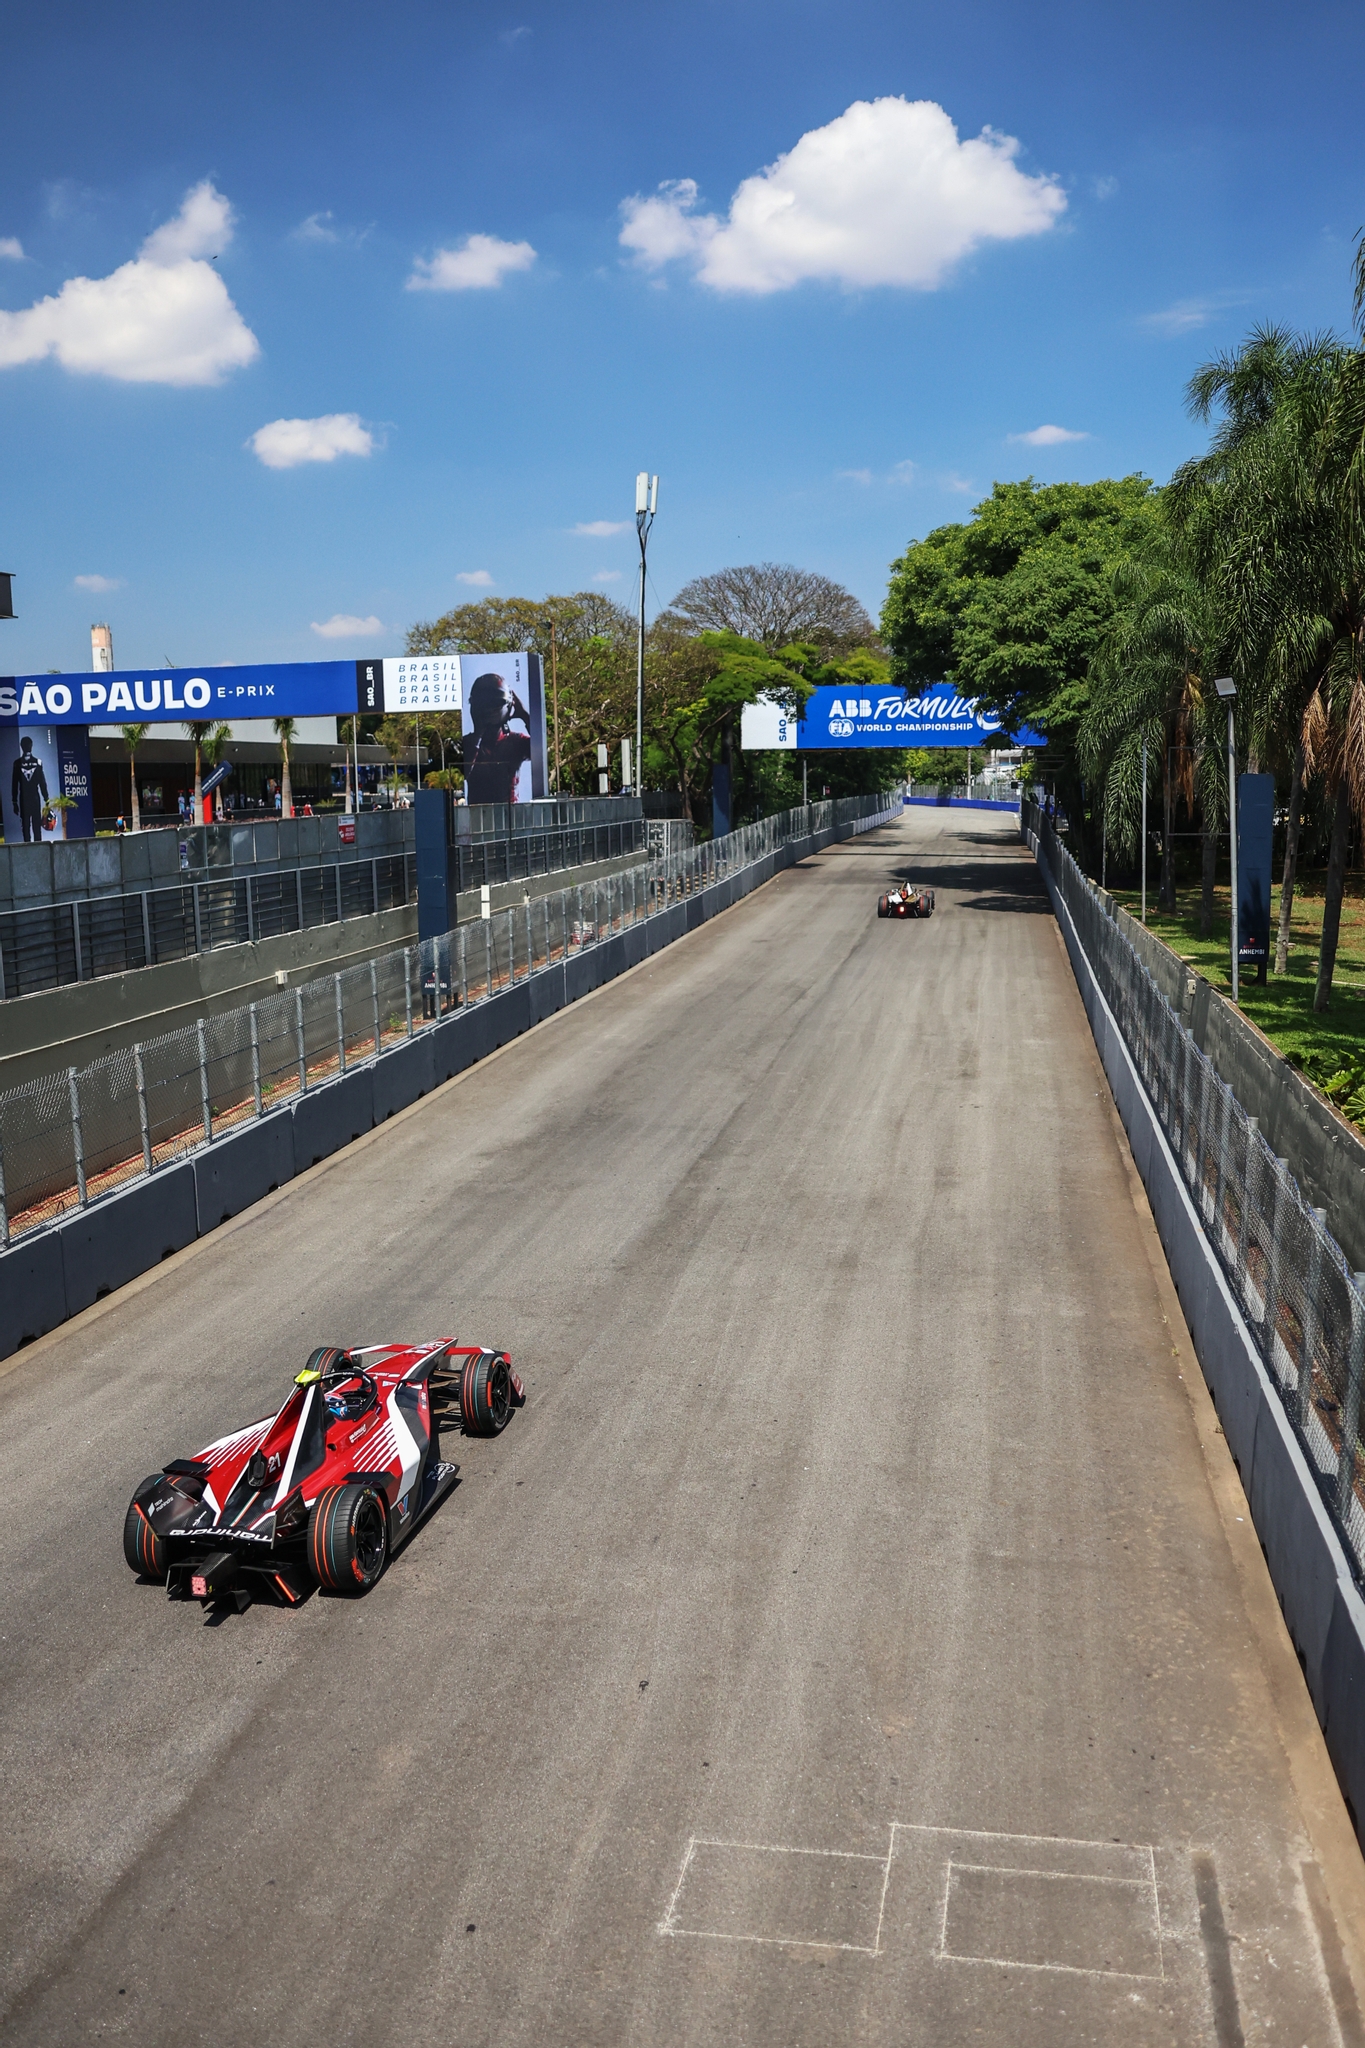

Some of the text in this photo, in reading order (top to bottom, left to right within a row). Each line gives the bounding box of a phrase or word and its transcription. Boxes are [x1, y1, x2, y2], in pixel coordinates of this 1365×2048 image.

[398, 662, 456, 672] BRASIL
[399, 673, 457, 683] BRASIL
[366, 666, 375, 707] SAO_BR
[399, 684, 457, 694] BRASIL
[0, 677, 275, 716] SÃO PAULO E-PRIX
[400, 694, 458, 704] BRASIL
[828, 699, 872, 718] ABB
[873, 695, 980, 720] FORMULA
[831, 722, 973, 734] FIA WORLD CHAMPIONSHIP
[63, 761, 78, 774] SÃO
[64, 776, 87, 785] PAULO
[65, 787, 88, 797] E-PRIX
[268, 1452, 281, 1473] 21
[169, 1527, 273, 1542] mahindra
